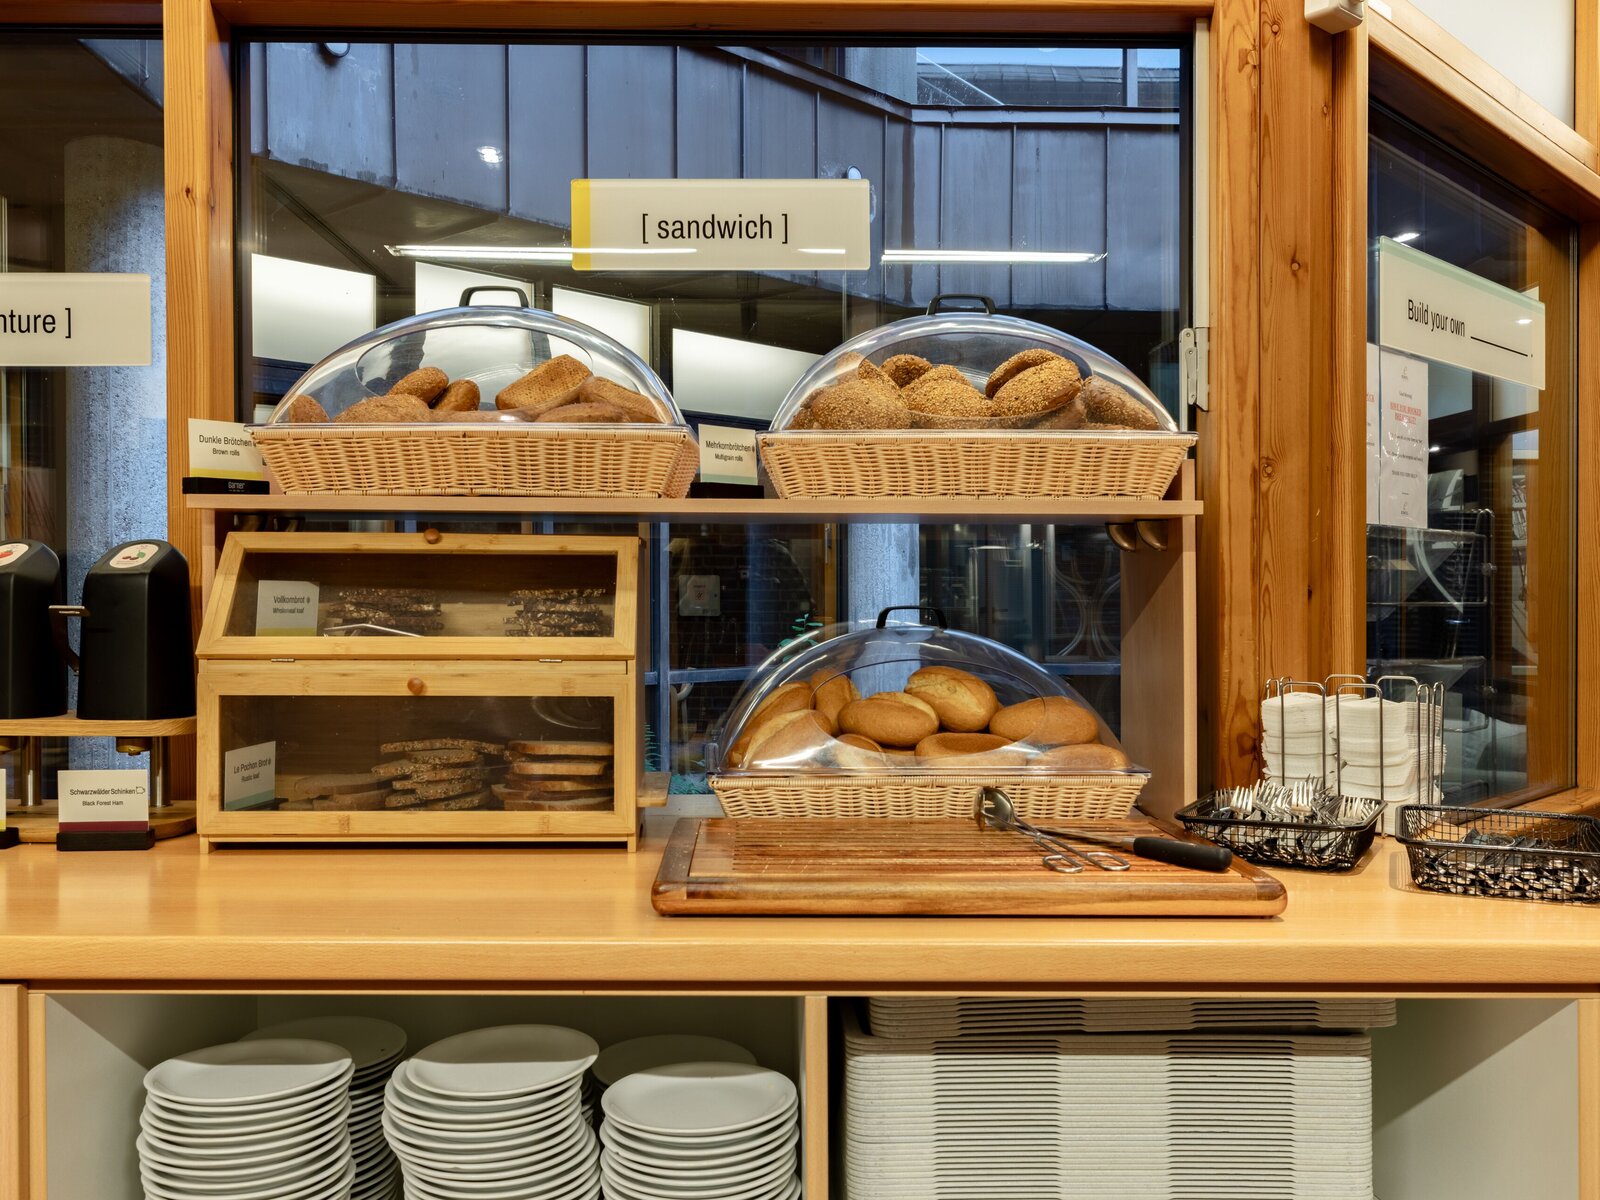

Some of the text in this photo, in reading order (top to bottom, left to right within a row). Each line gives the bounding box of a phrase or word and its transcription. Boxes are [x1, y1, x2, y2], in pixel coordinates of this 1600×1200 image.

[657, 213, 773, 239] sandwich
[1408, 299, 1466, 337] Build your own
[199, 434, 252, 447] Dunkle Brötchen
[69, 788, 110, 796] Schwarzwälder
